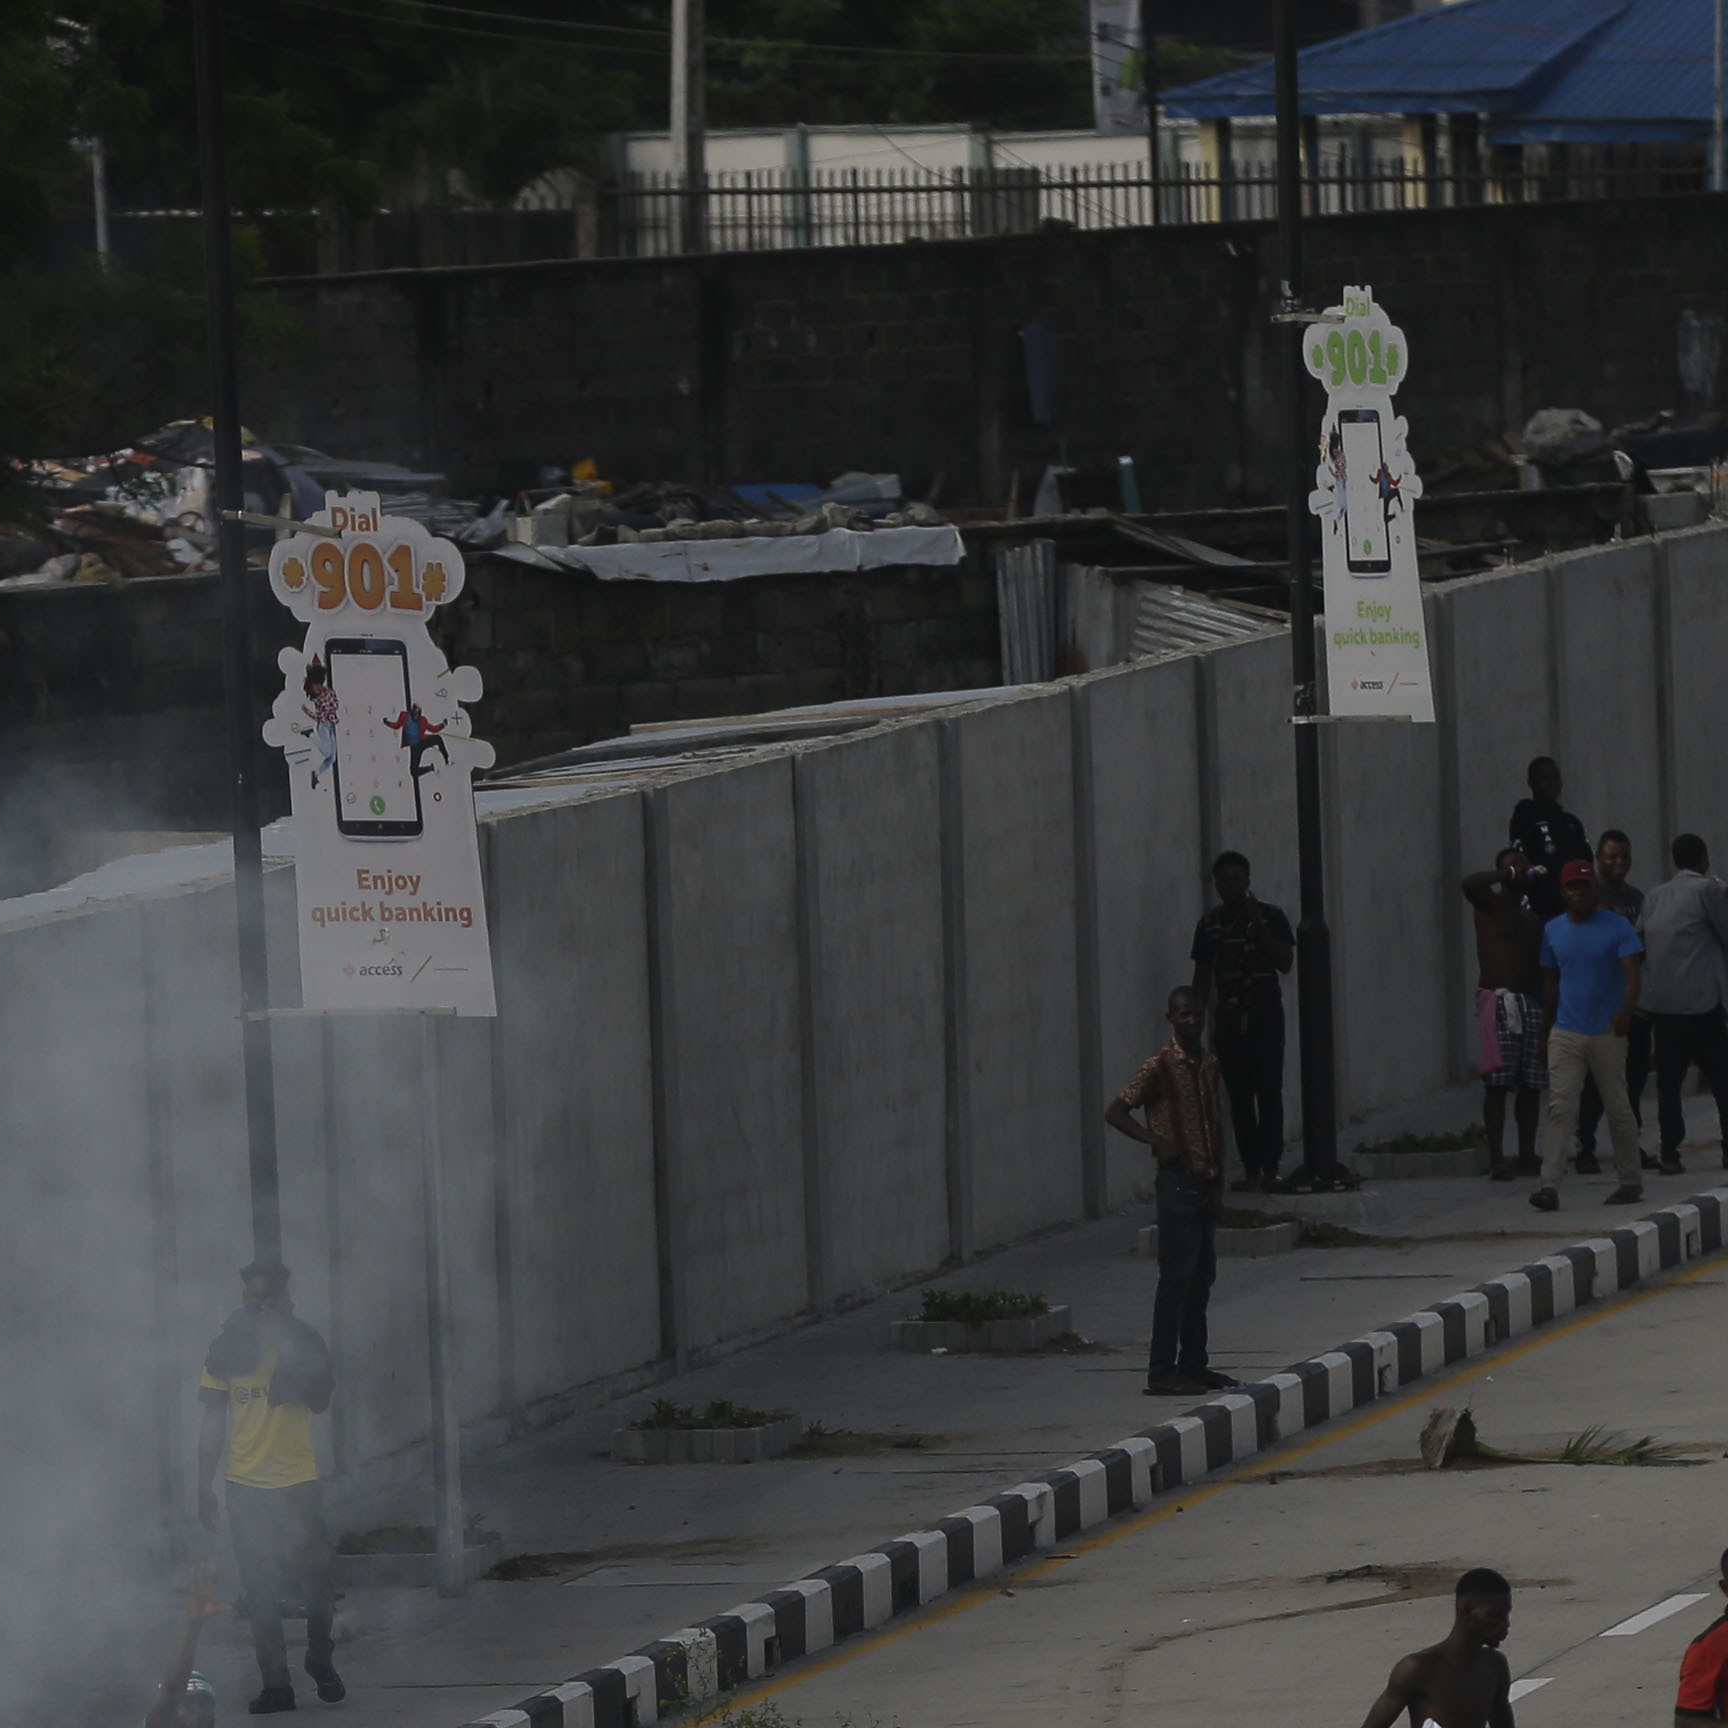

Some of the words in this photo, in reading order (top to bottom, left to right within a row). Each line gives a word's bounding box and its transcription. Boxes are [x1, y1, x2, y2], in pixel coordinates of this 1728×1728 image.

[1346, 297, 1370, 316] Dial
[331, 507, 378, 532] Dial
[1357, 600, 1392, 623] Enjoy
[1334, 627, 1368, 649] quick
[1370, 627, 1420, 649] banking
[356, 868, 422, 896] Enjoy
[311, 901, 375, 928] quick
[379, 901, 473, 928] banking
[359, 964, 403, 976] access
